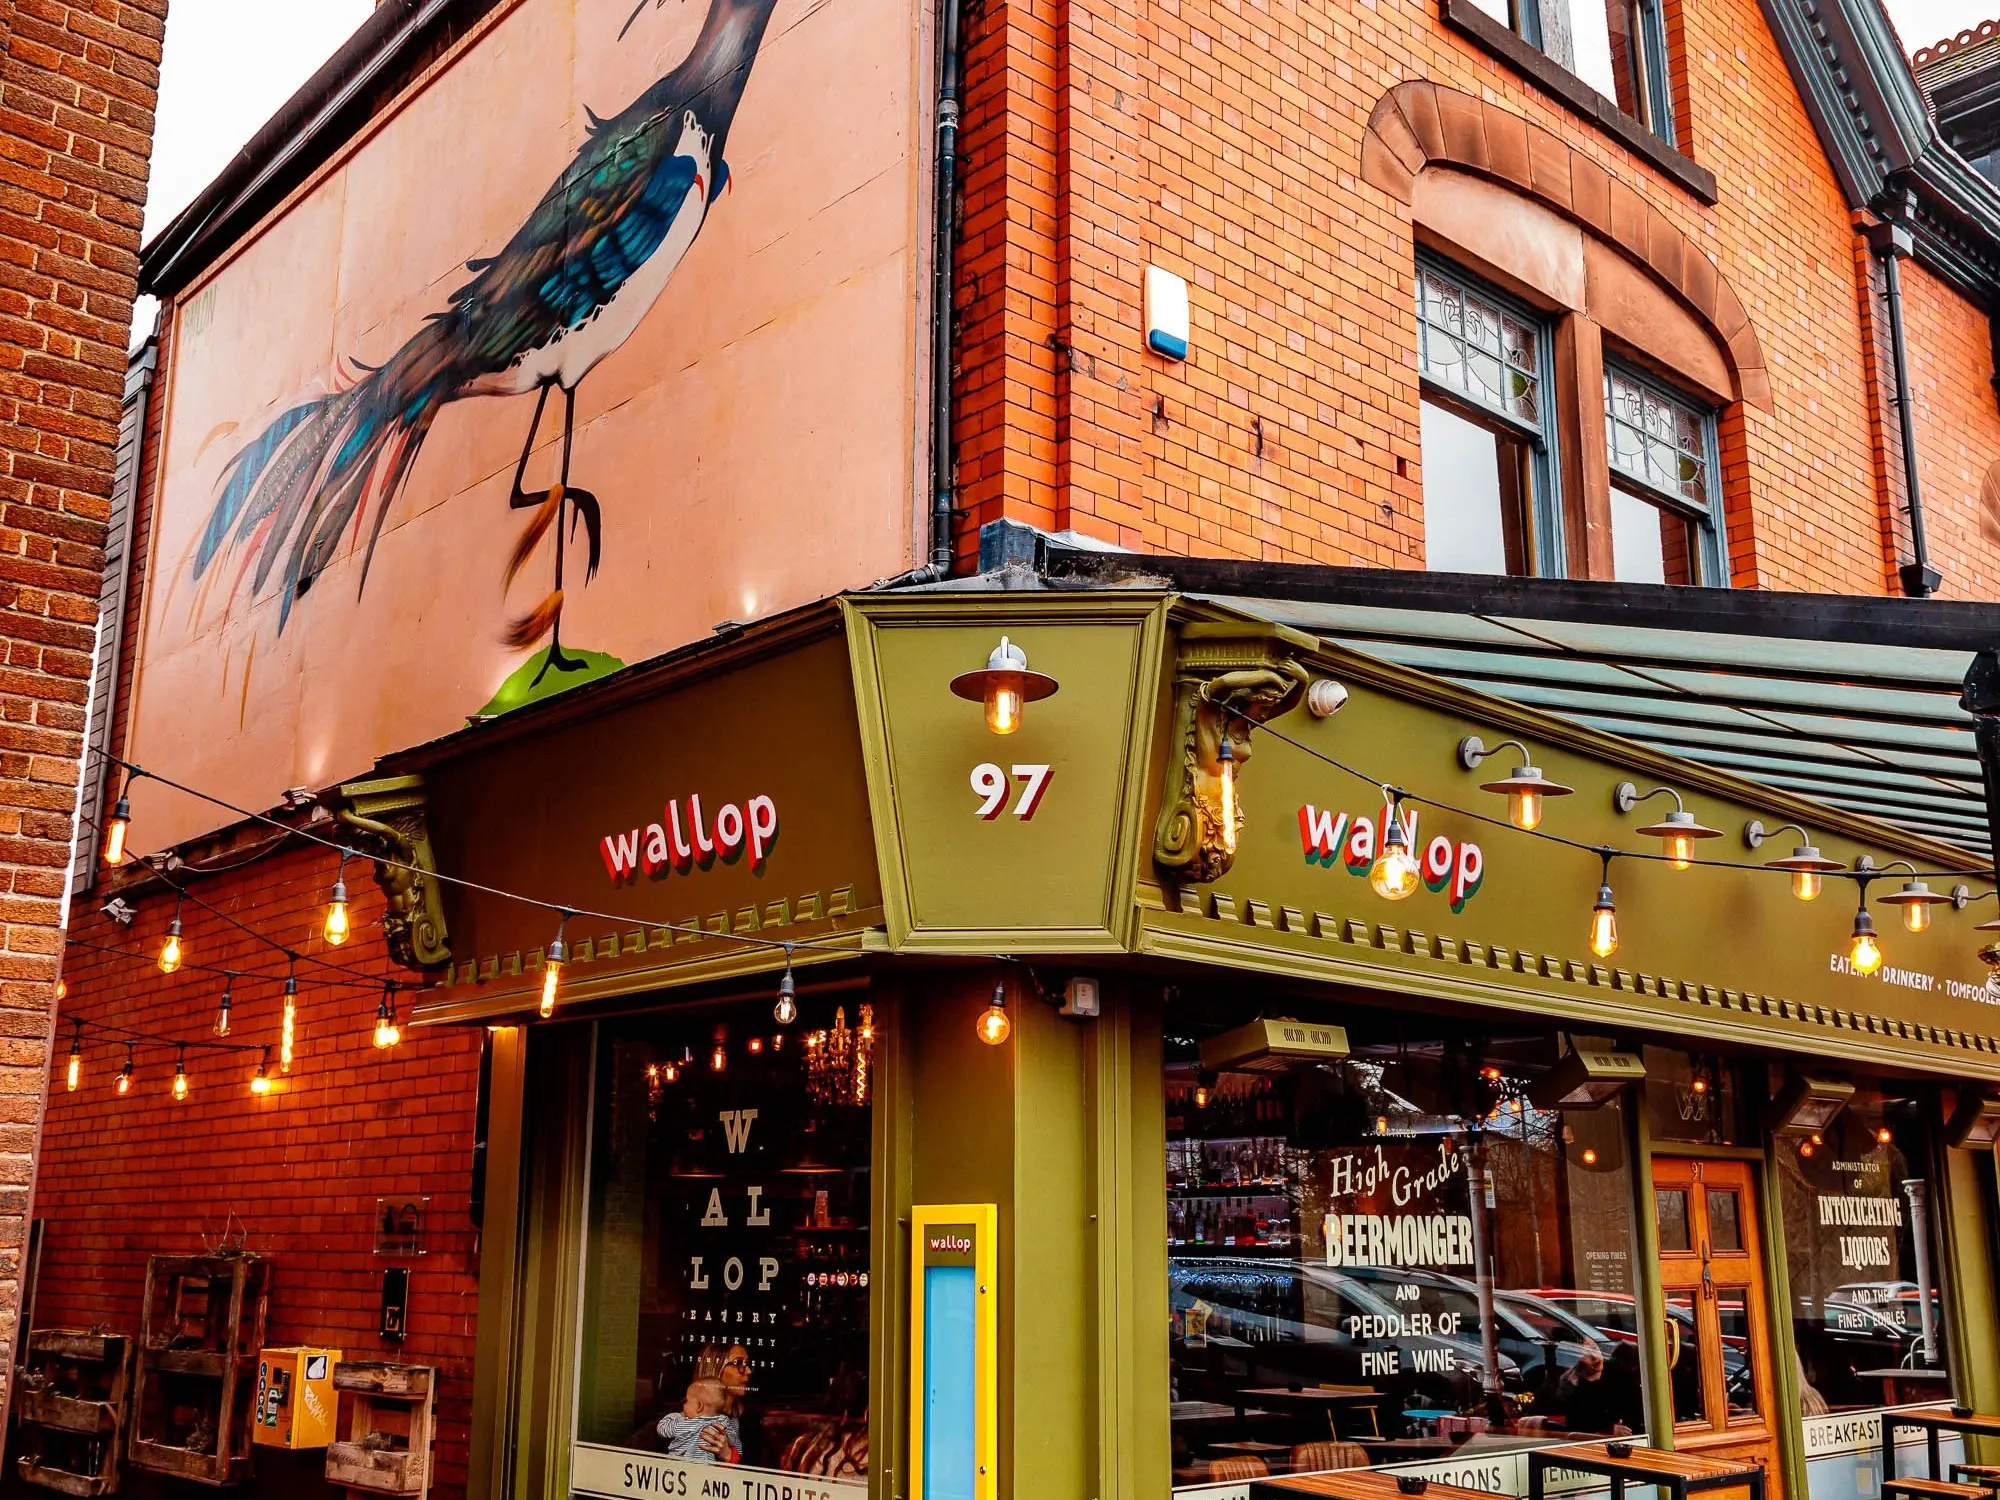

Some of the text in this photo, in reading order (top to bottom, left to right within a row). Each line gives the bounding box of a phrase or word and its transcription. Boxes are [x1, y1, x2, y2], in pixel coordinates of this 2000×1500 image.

[970, 763, 1055, 821] 97
[600, 793, 778, 882] wallop
[1882, 965, 1934, 992] DRINKERY
[719, 1108, 758, 1153] W
[1330, 1143, 1460, 1206] High Grade
[1691, 1162, 1704, 1181] 97
[1832, 1160, 1881, 1173] ADMINISTRATOR
[1853, 1179, 1863, 1189] OF
[1817, 1195, 1903, 1227] INTOXICATING
[930, 1234, 971, 1255] wallop
[1325, 1213, 1475, 1267] BEERMONGER
[1839, 1236, 1891, 1271] LIQUORS
[1395, 1284, 1420, 1301] AND
[1851, 1289, 1889, 1305] AND THE
[1350, 1312, 1461, 1339] PEDDLER OF
[1838, 1310, 1906, 1329] FINEST EDIBLES
[1361, 1348, 1455, 1377] FINE WINE
[1810, 1419, 1880, 1448] BREAKFAST
[623, 1462, 687, 1496] SWIGS
[701, 1479, 730, 1499] AND
